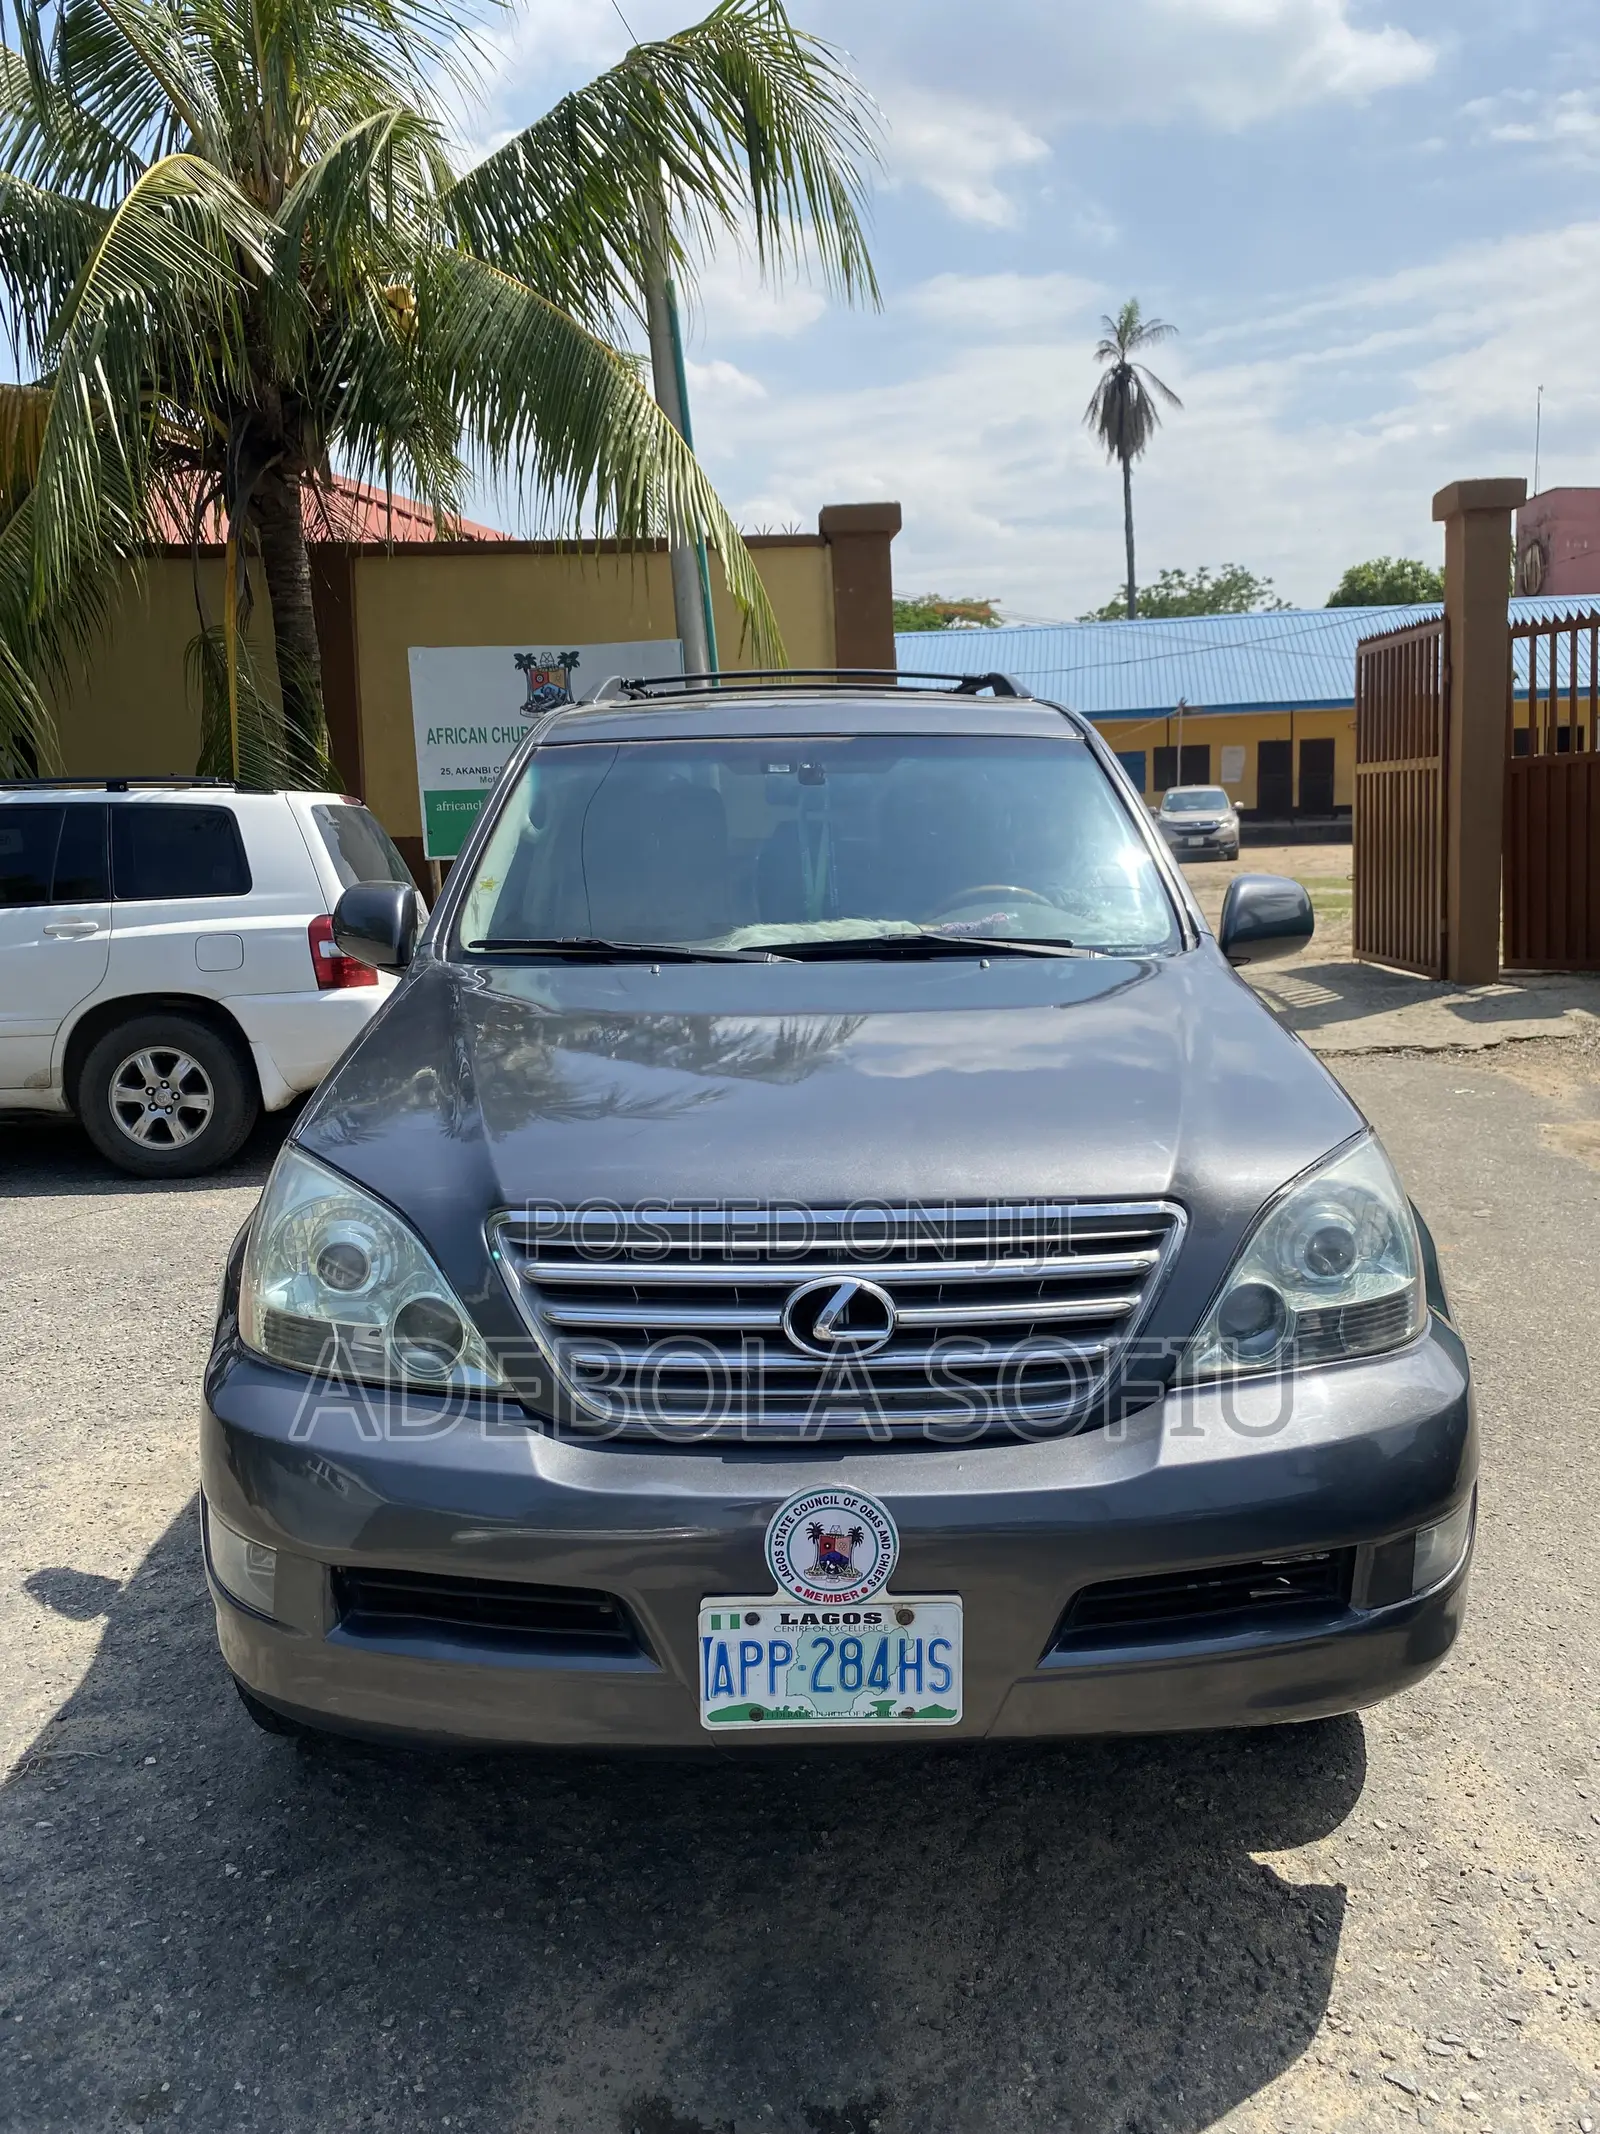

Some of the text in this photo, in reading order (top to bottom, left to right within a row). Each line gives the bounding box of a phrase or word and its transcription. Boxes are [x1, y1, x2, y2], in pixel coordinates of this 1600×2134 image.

[427, 726, 487, 745] AFRICAN
[440, 767, 454, 776] 25,
[455, 766, 491, 775] AKANBI
[775, 1496, 891, 1587] LAGOS STATE COUNCIL OF OBAS AND CHIEFS
[803, 1588, 860, 1603] MEMBER
[780, 1612, 882, 1625] LAGOS
[774, 1624, 889, 1633] CENTRE OF EXCELLENCE
